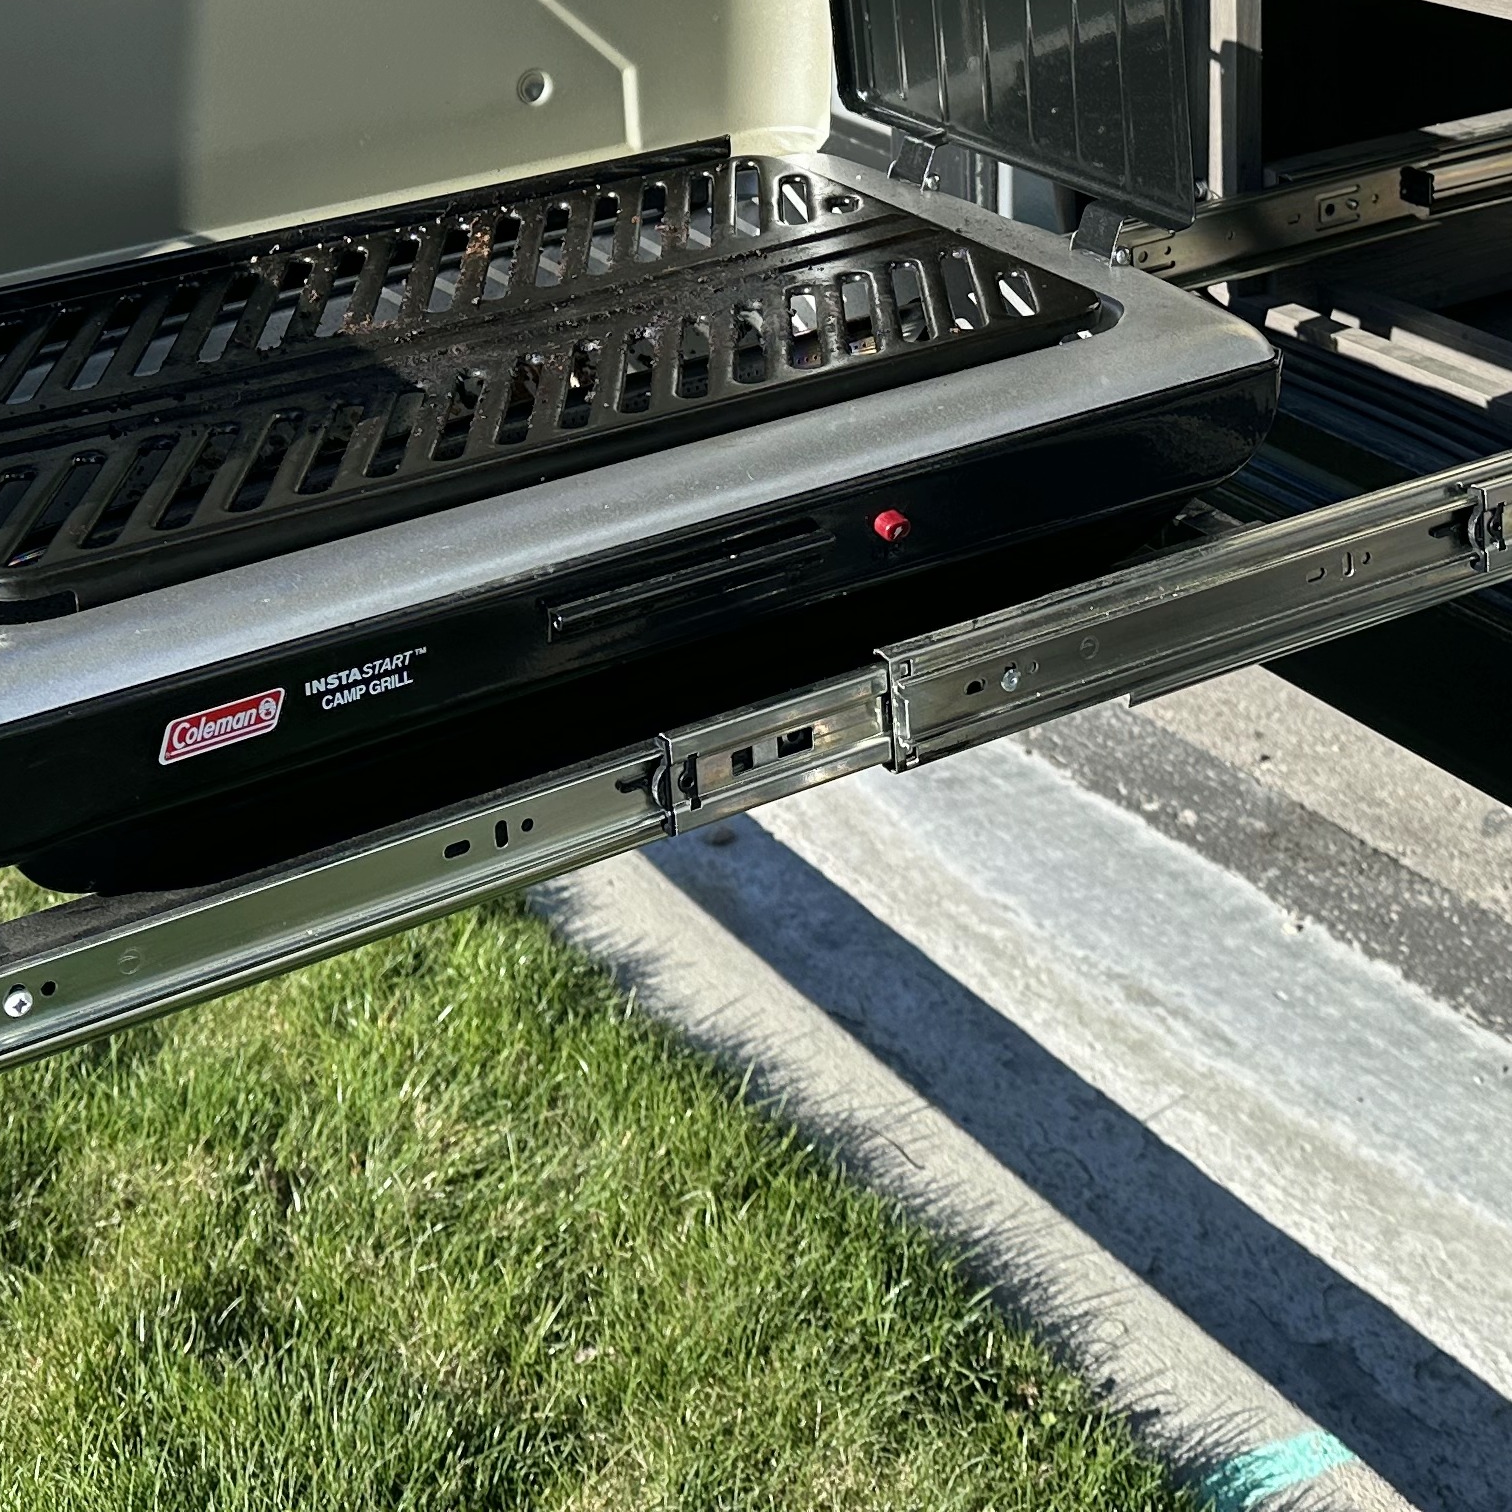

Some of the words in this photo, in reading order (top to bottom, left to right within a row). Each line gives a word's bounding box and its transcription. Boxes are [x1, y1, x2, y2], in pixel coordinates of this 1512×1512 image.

[321, 683, 366, 710] CAMP
[368, 670, 414, 696] GRILL
[172, 707, 257, 750] Coleman
